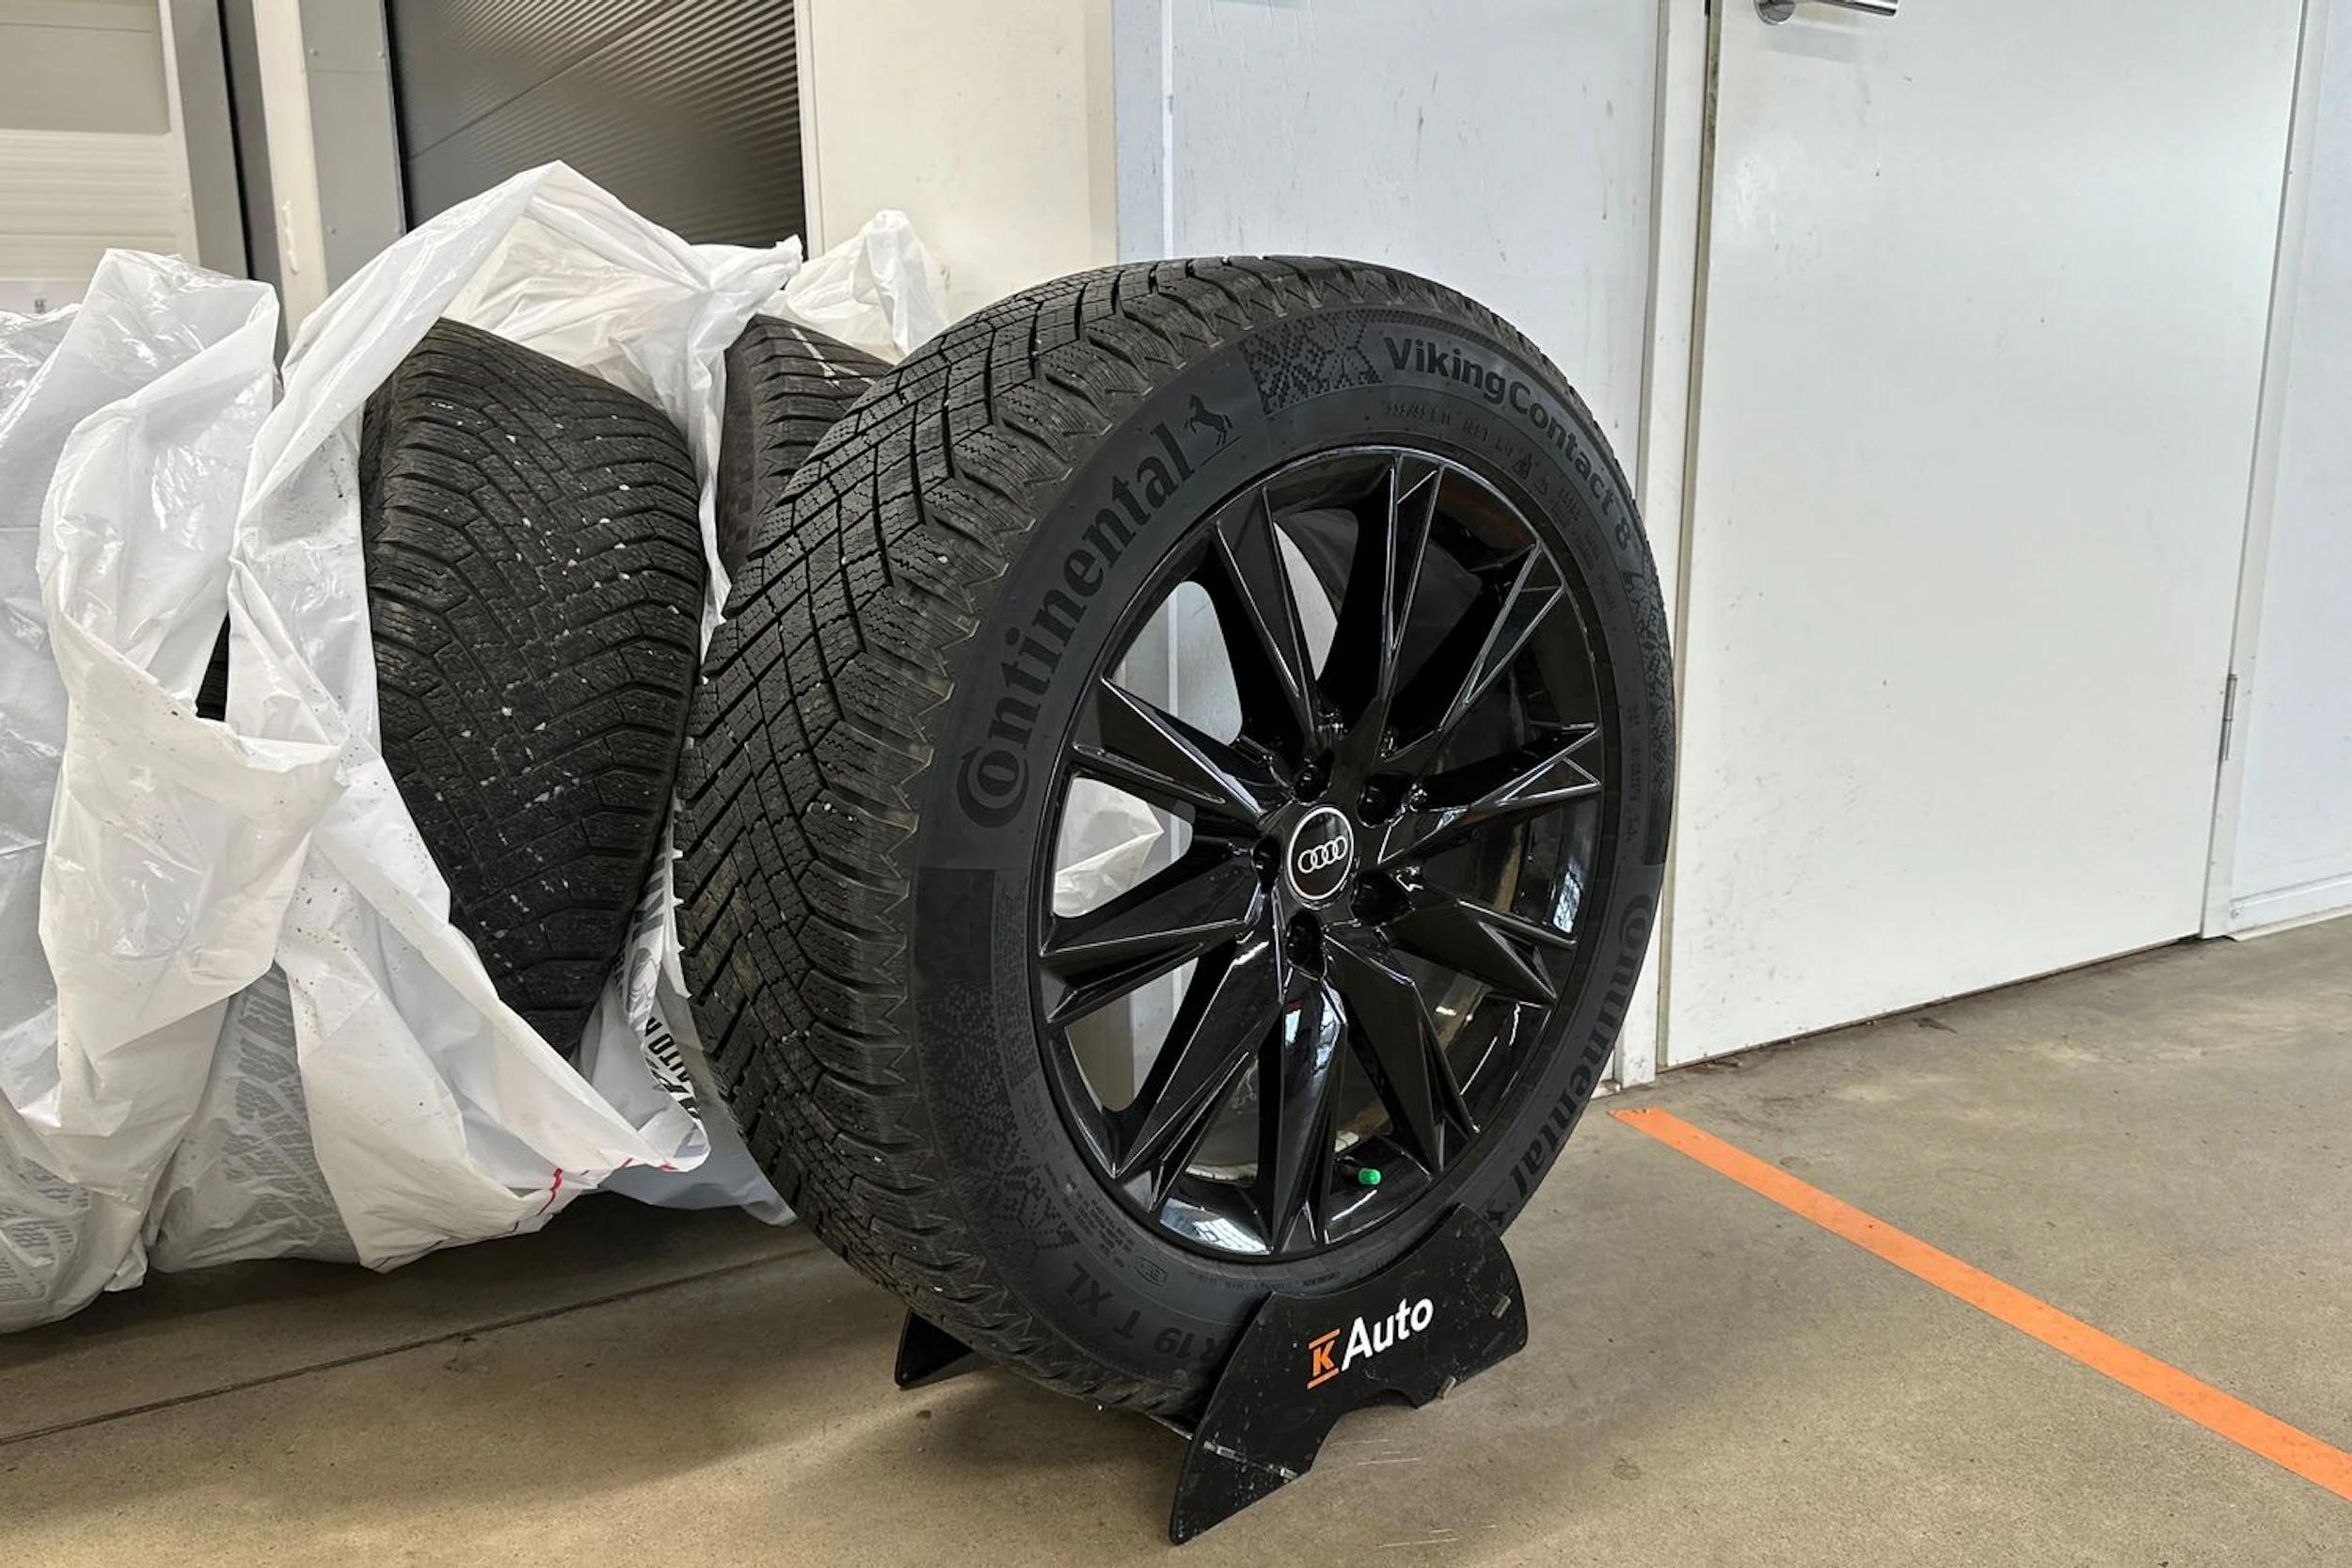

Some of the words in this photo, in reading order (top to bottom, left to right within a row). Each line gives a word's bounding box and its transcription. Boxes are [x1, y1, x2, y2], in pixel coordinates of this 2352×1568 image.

[1384, 336, 1617, 517] VikingContact
[957, 422, 1193, 829] Continental
[1061, 1261, 1114, 1318] XL
